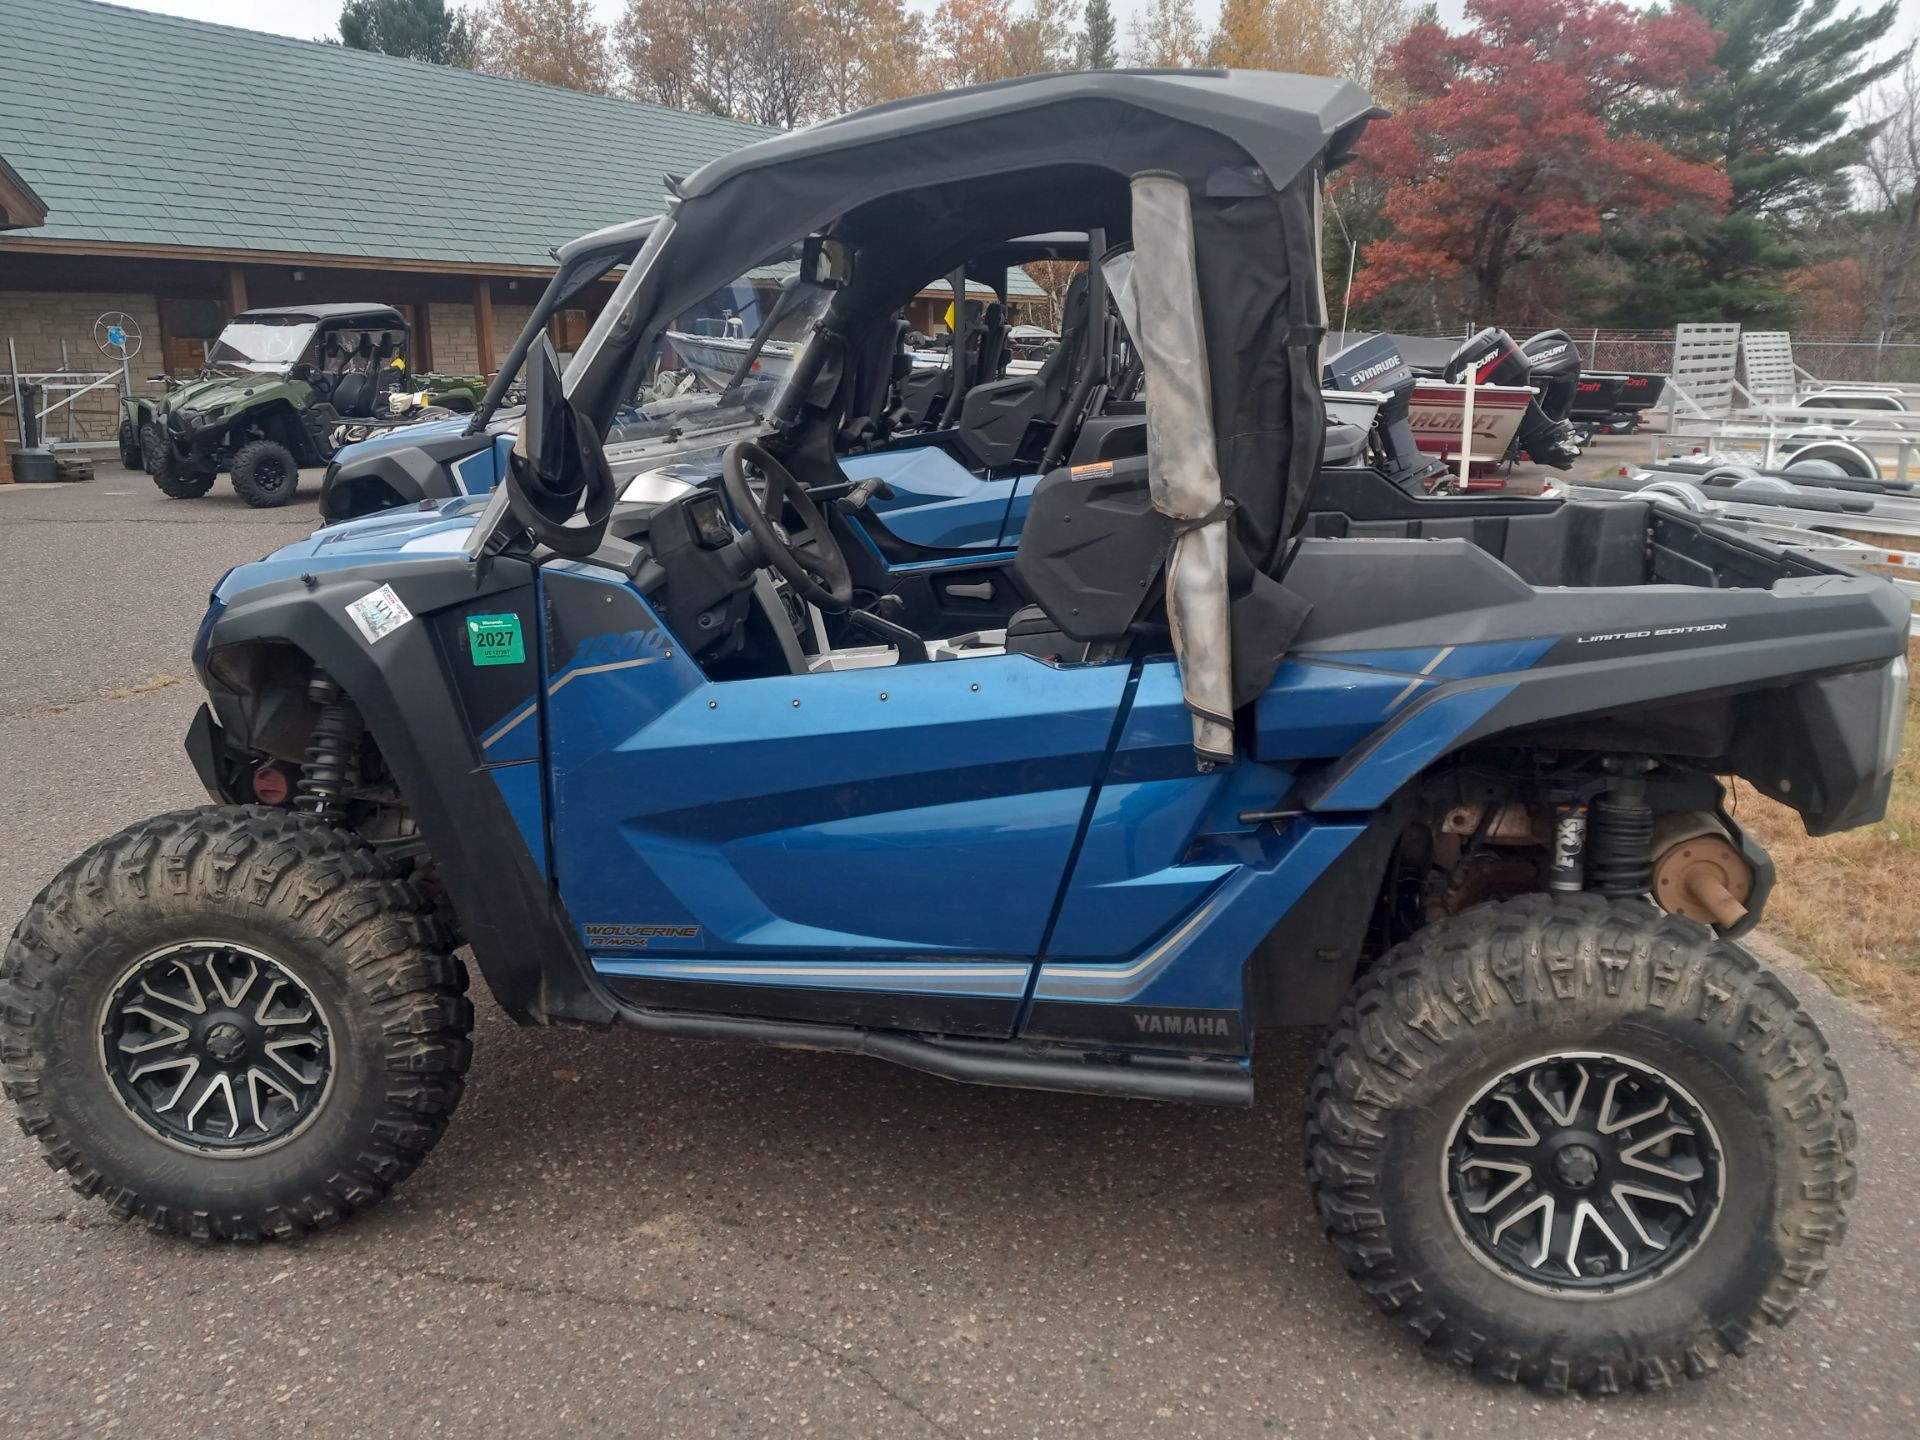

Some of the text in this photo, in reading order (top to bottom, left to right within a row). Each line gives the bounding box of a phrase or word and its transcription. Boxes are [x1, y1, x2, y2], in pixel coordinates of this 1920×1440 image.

[1530, 343, 1568, 363] ERCURY
[1350, 354, 1401, 386] EVINRUDE
[476, 631, 514, 648] 2027
[1577, 623, 1728, 644] LIMITED EDITION
[1555, 821, 1582, 868] FOX
[585, 925, 700, 937] WOLVERINE
[1134, 1014, 1230, 1036] YAMAHA
